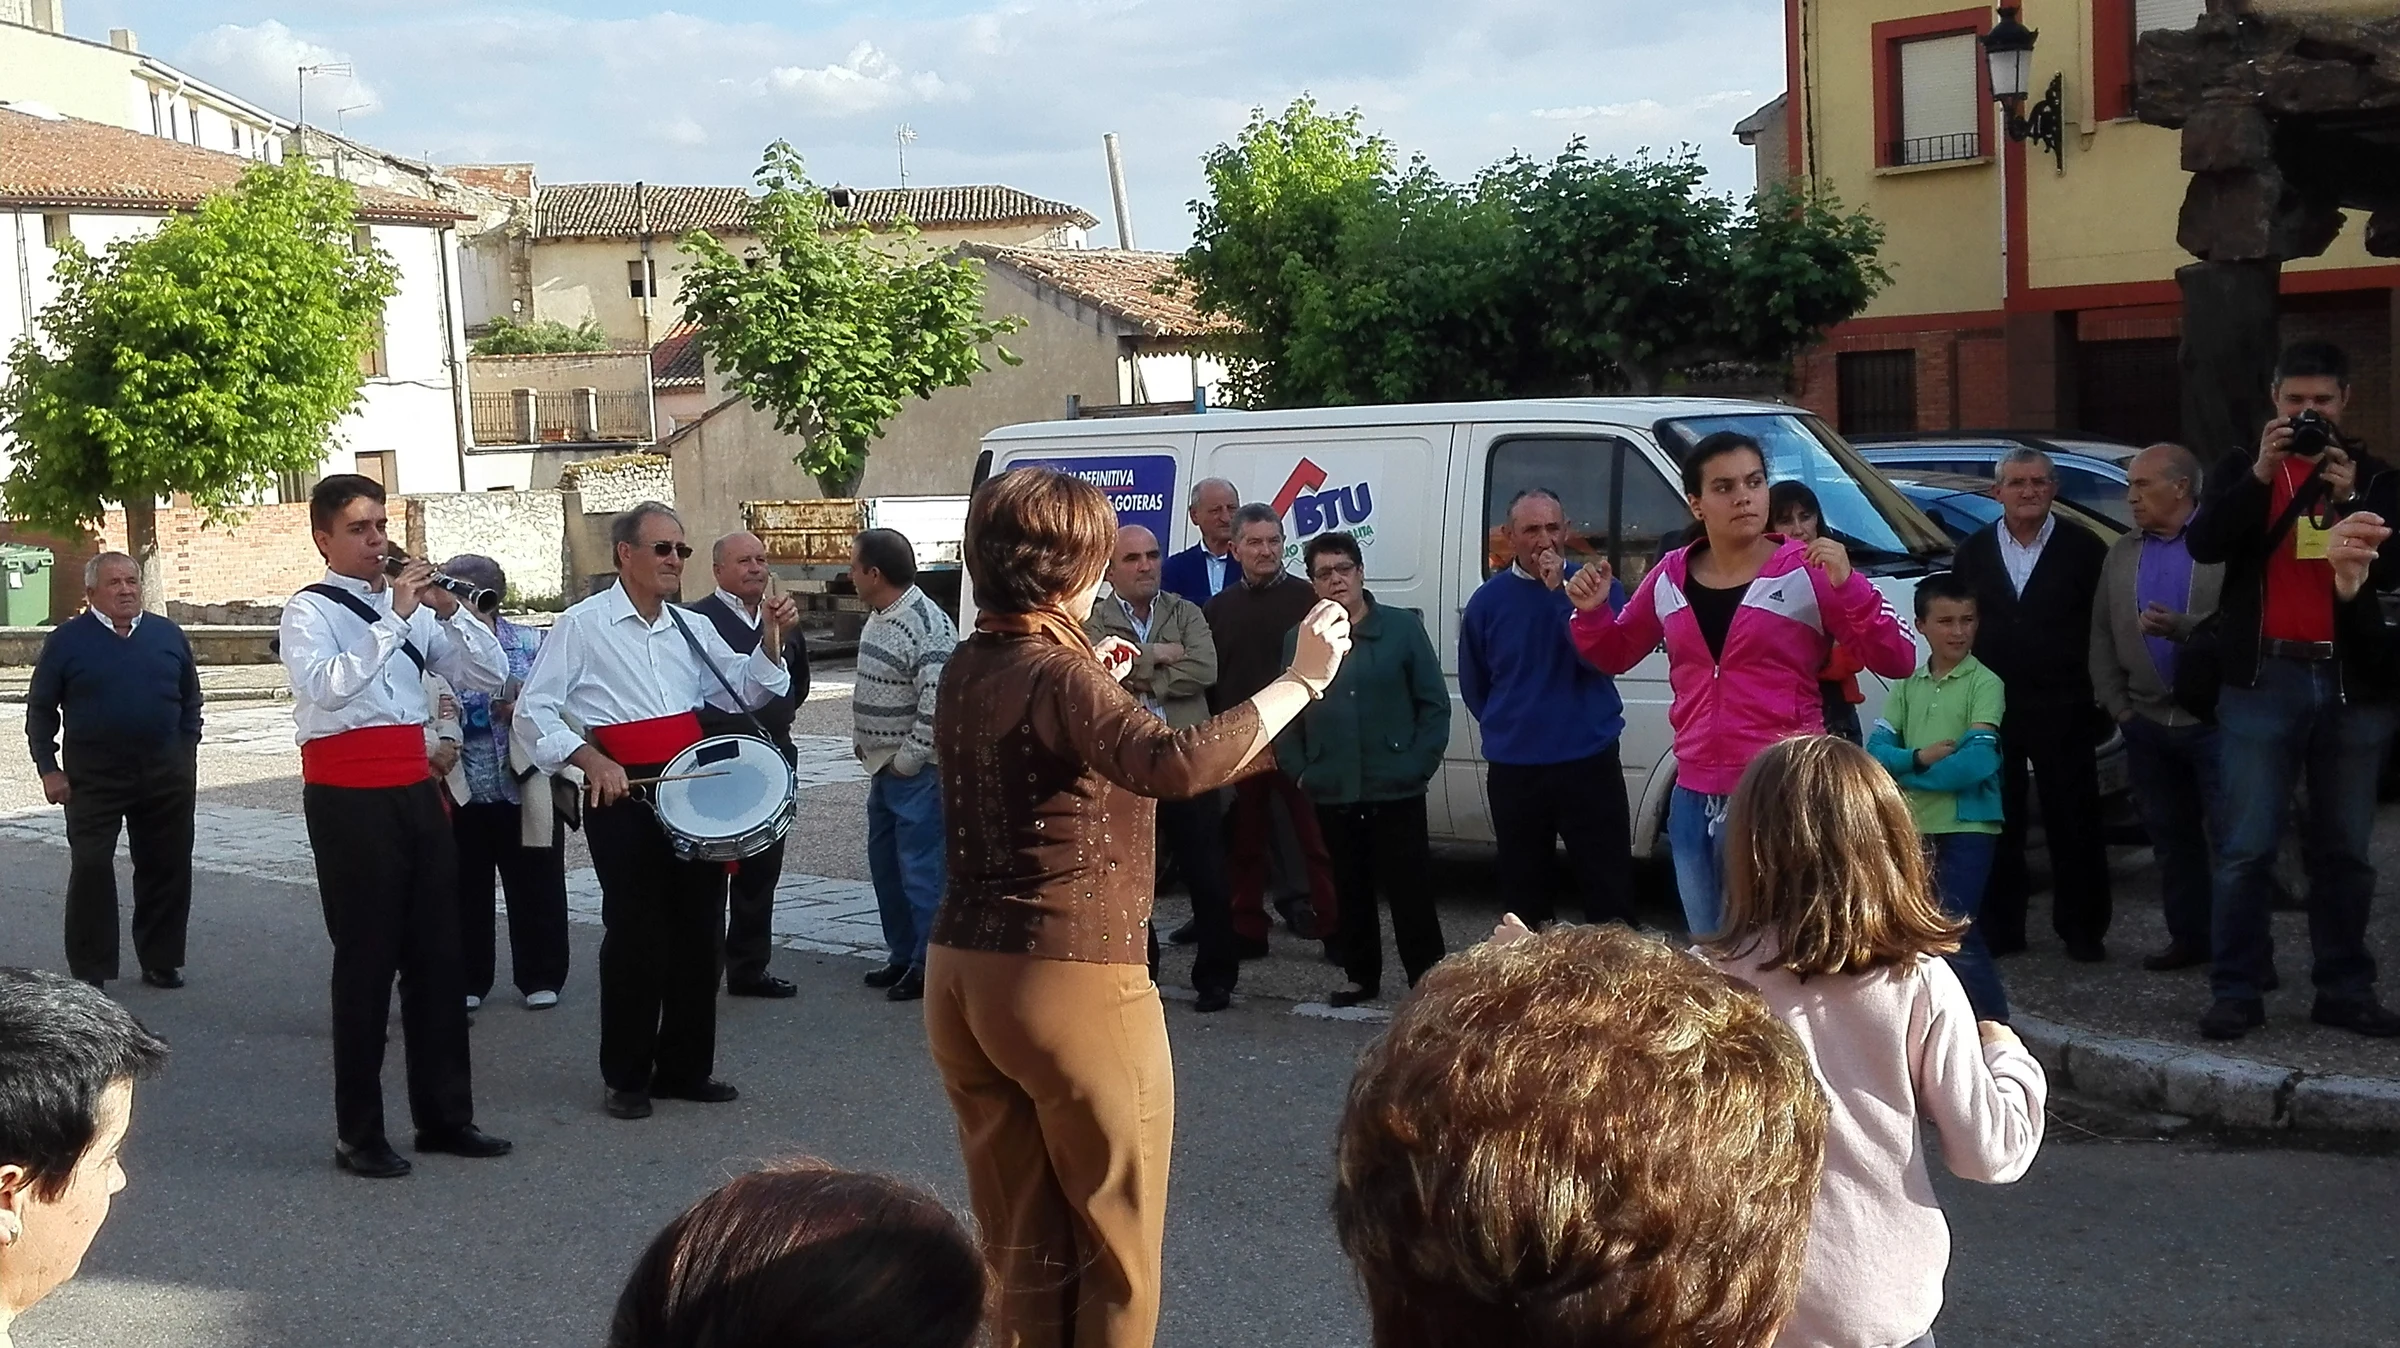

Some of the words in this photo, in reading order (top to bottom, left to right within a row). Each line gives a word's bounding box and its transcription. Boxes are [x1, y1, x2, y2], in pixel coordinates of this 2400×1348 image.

[1079, 469, 1135, 486] DEFINITIVA
[1114, 493, 1164, 512] GOTERAS
[1293, 482, 1373, 538] BTU
